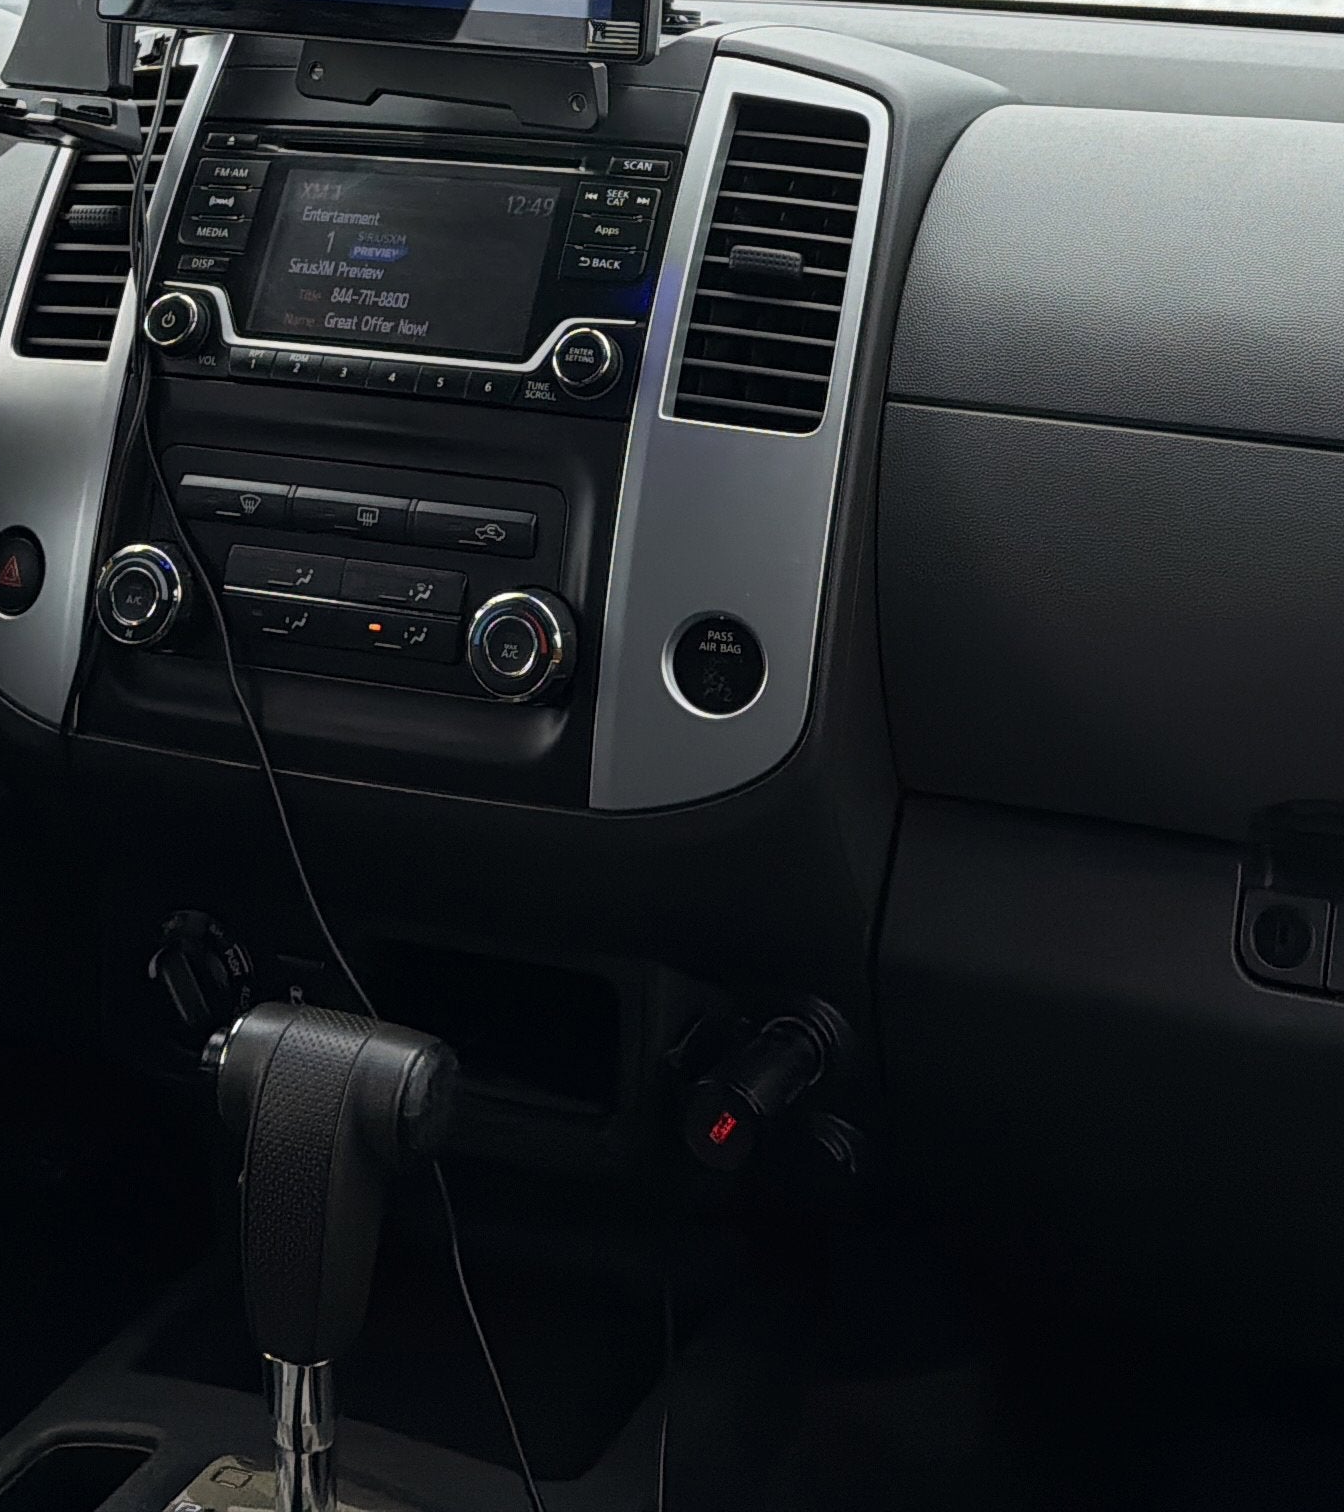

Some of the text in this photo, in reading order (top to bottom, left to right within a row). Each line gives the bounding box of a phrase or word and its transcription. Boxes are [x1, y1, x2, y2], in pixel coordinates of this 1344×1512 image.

[623, 161, 652, 172] SCAN
[606, 188, 630, 199] SEEK
[507, 194, 555, 216] 12:49
[606, 197, 626, 207] CAT
[302, 206, 381, 226] Entertainment
[197, 227, 229, 238] MEDIA
[594, 225, 620, 236] Apps
[326, 230, 336, 253] 1
[192, 258, 215, 268] DISP
[592, 258, 621, 270] BACK
[288, 257, 385, 281] SiriusXM Preview
[331, 287, 410, 309] 844-711-8800
[324, 313, 358, 330] Great
[361, 315, 396, 334] Offer
[397, 320, 429, 337] Now!
[568, 347, 594, 356] ENTER
[199, 355, 216, 366] VOL
[250, 359, 256, 369] 1
[565, 353, 595, 364] SETTING
[293, 363, 301, 373] 2
[340, 367, 348, 378] 3
[387, 372, 396, 383] 4
[436, 377, 444, 388] 5
[484, 382, 492, 392] 6
[527, 381, 550, 391] TUNE
[524, 390, 556, 401] SCROLL
[126, 595, 143, 605] A/C
[707, 630, 734, 643] PASS
[698, 641, 742, 655] AIR BAG
[500, 649, 519, 660] A/C
